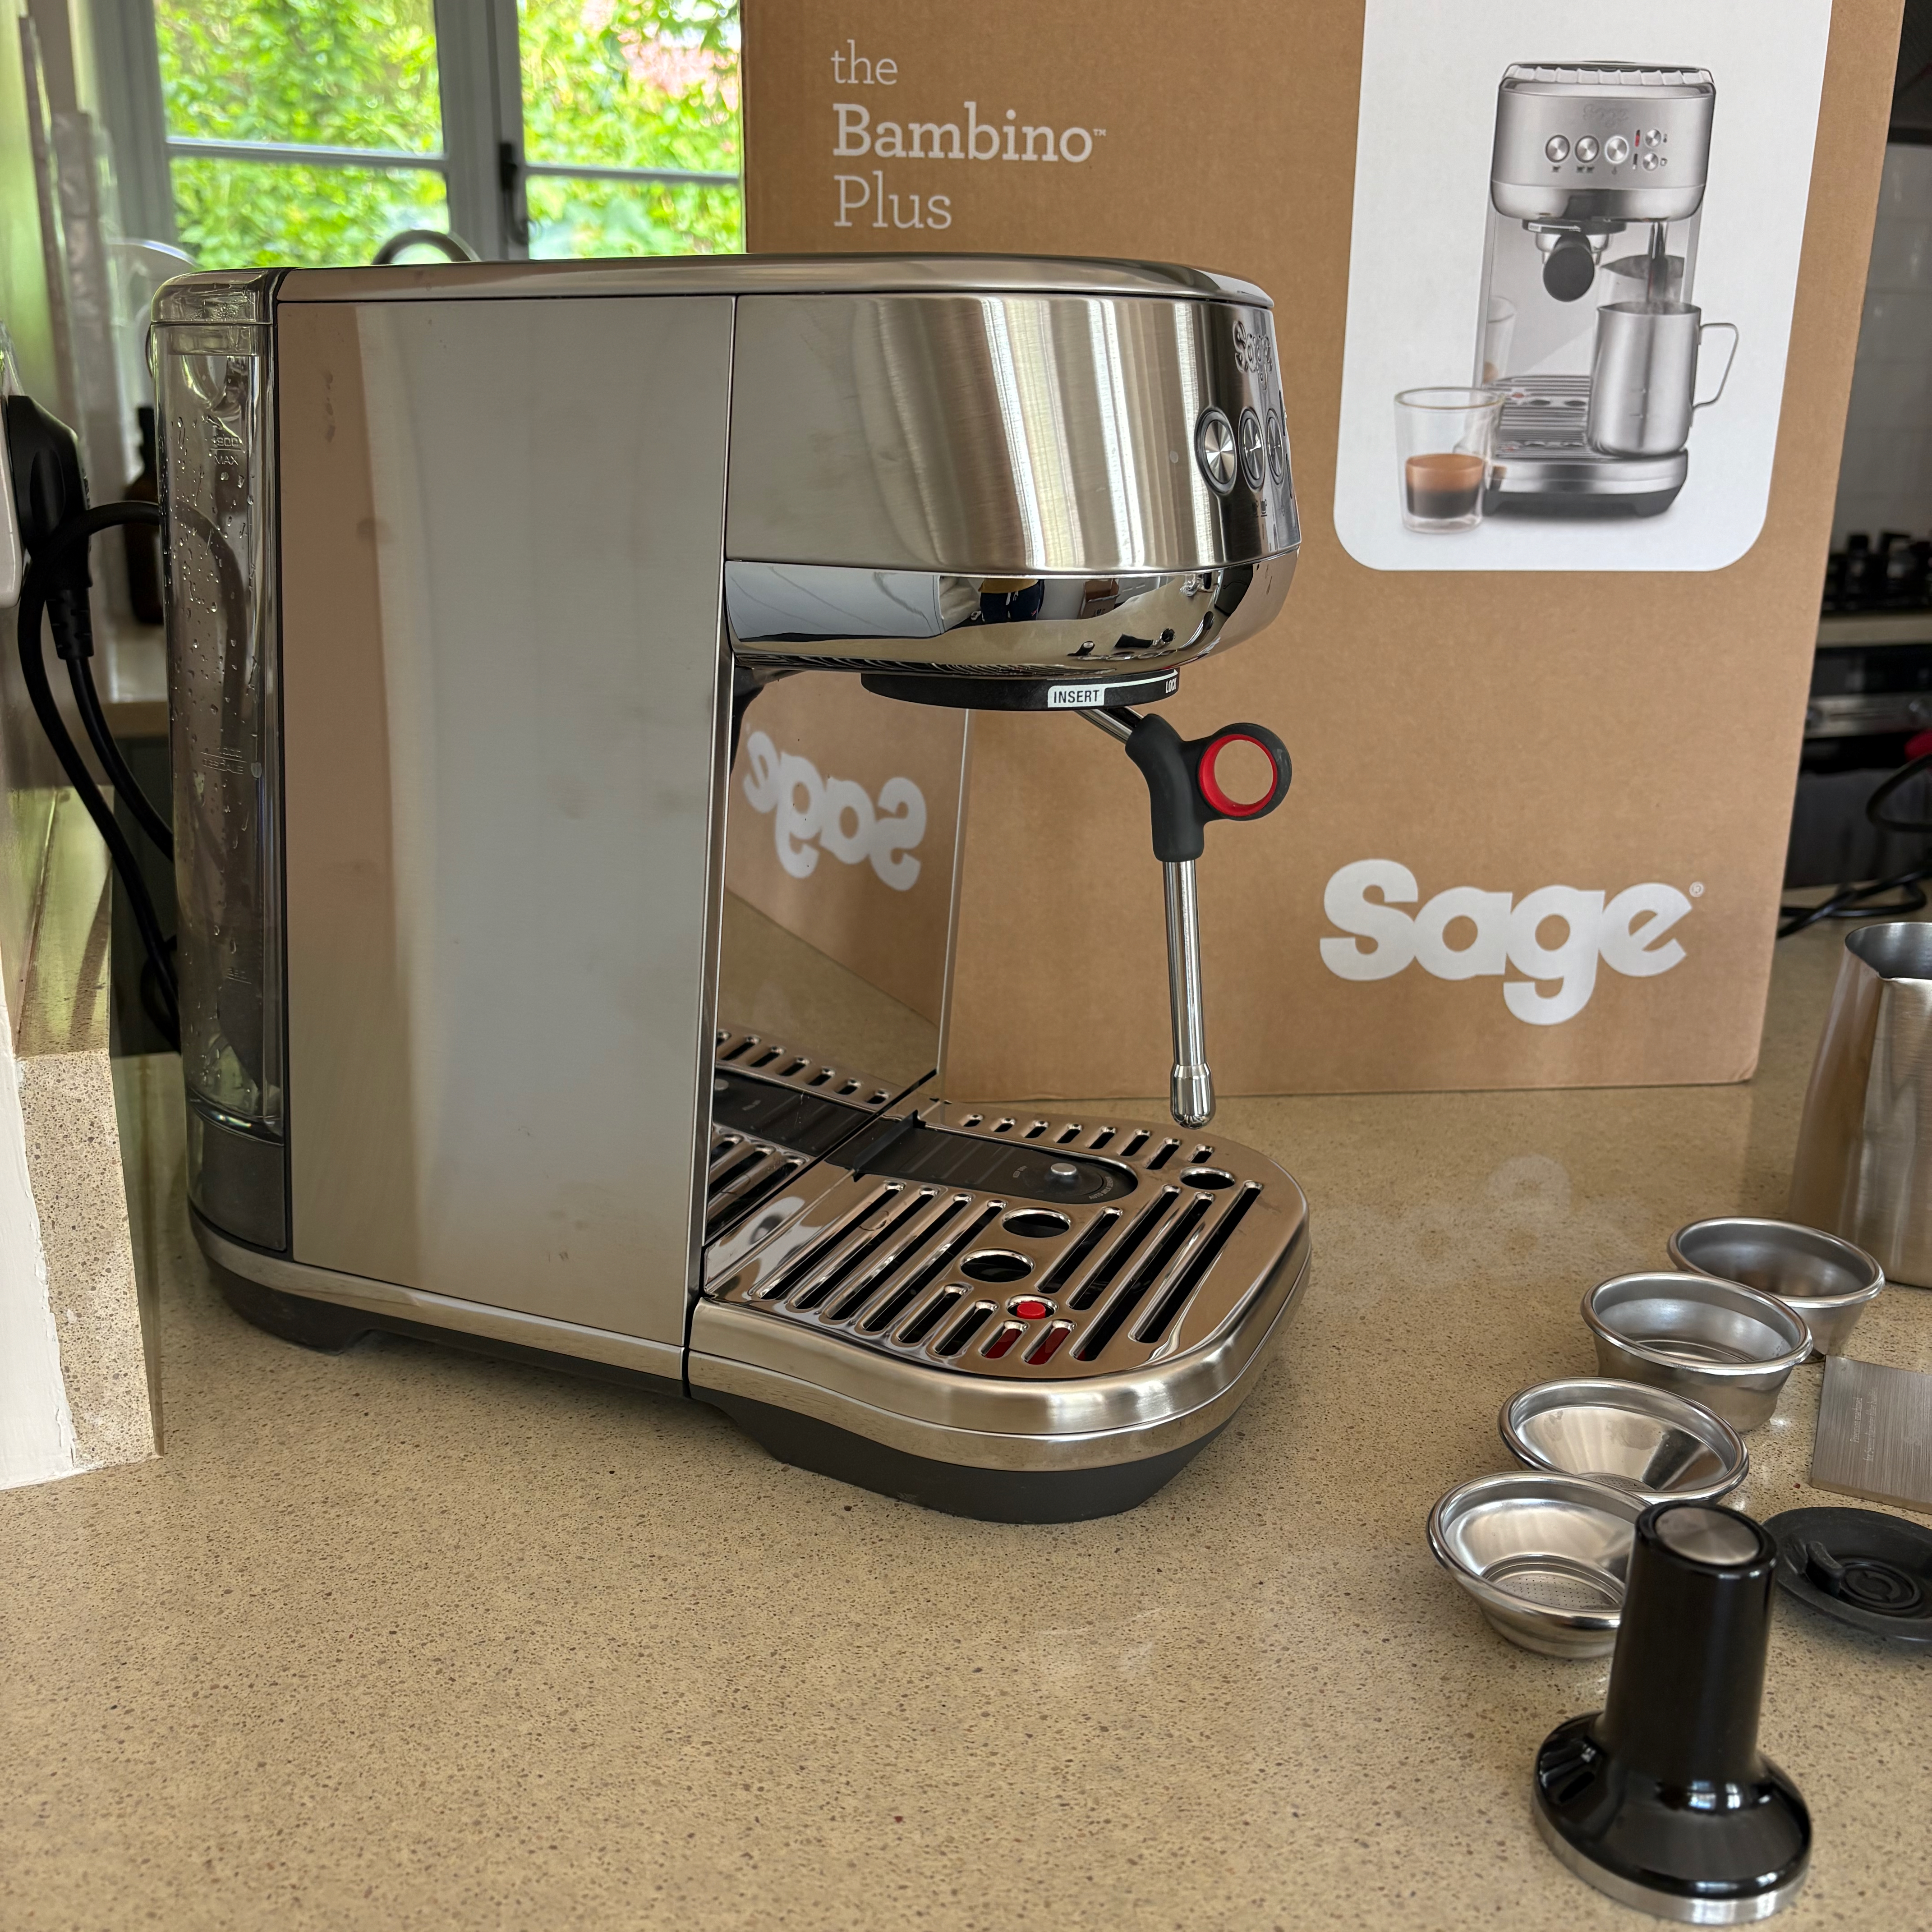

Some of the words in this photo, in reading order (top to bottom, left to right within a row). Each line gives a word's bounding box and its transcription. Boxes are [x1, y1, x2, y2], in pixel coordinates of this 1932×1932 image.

[830, 39, 898, 85] the
[833, 170, 952, 229] Plus
[214, 455, 239, 466] MAX
[1165, 677, 1177, 694] LOCK
[1053, 690, 1100, 704] INSERT
